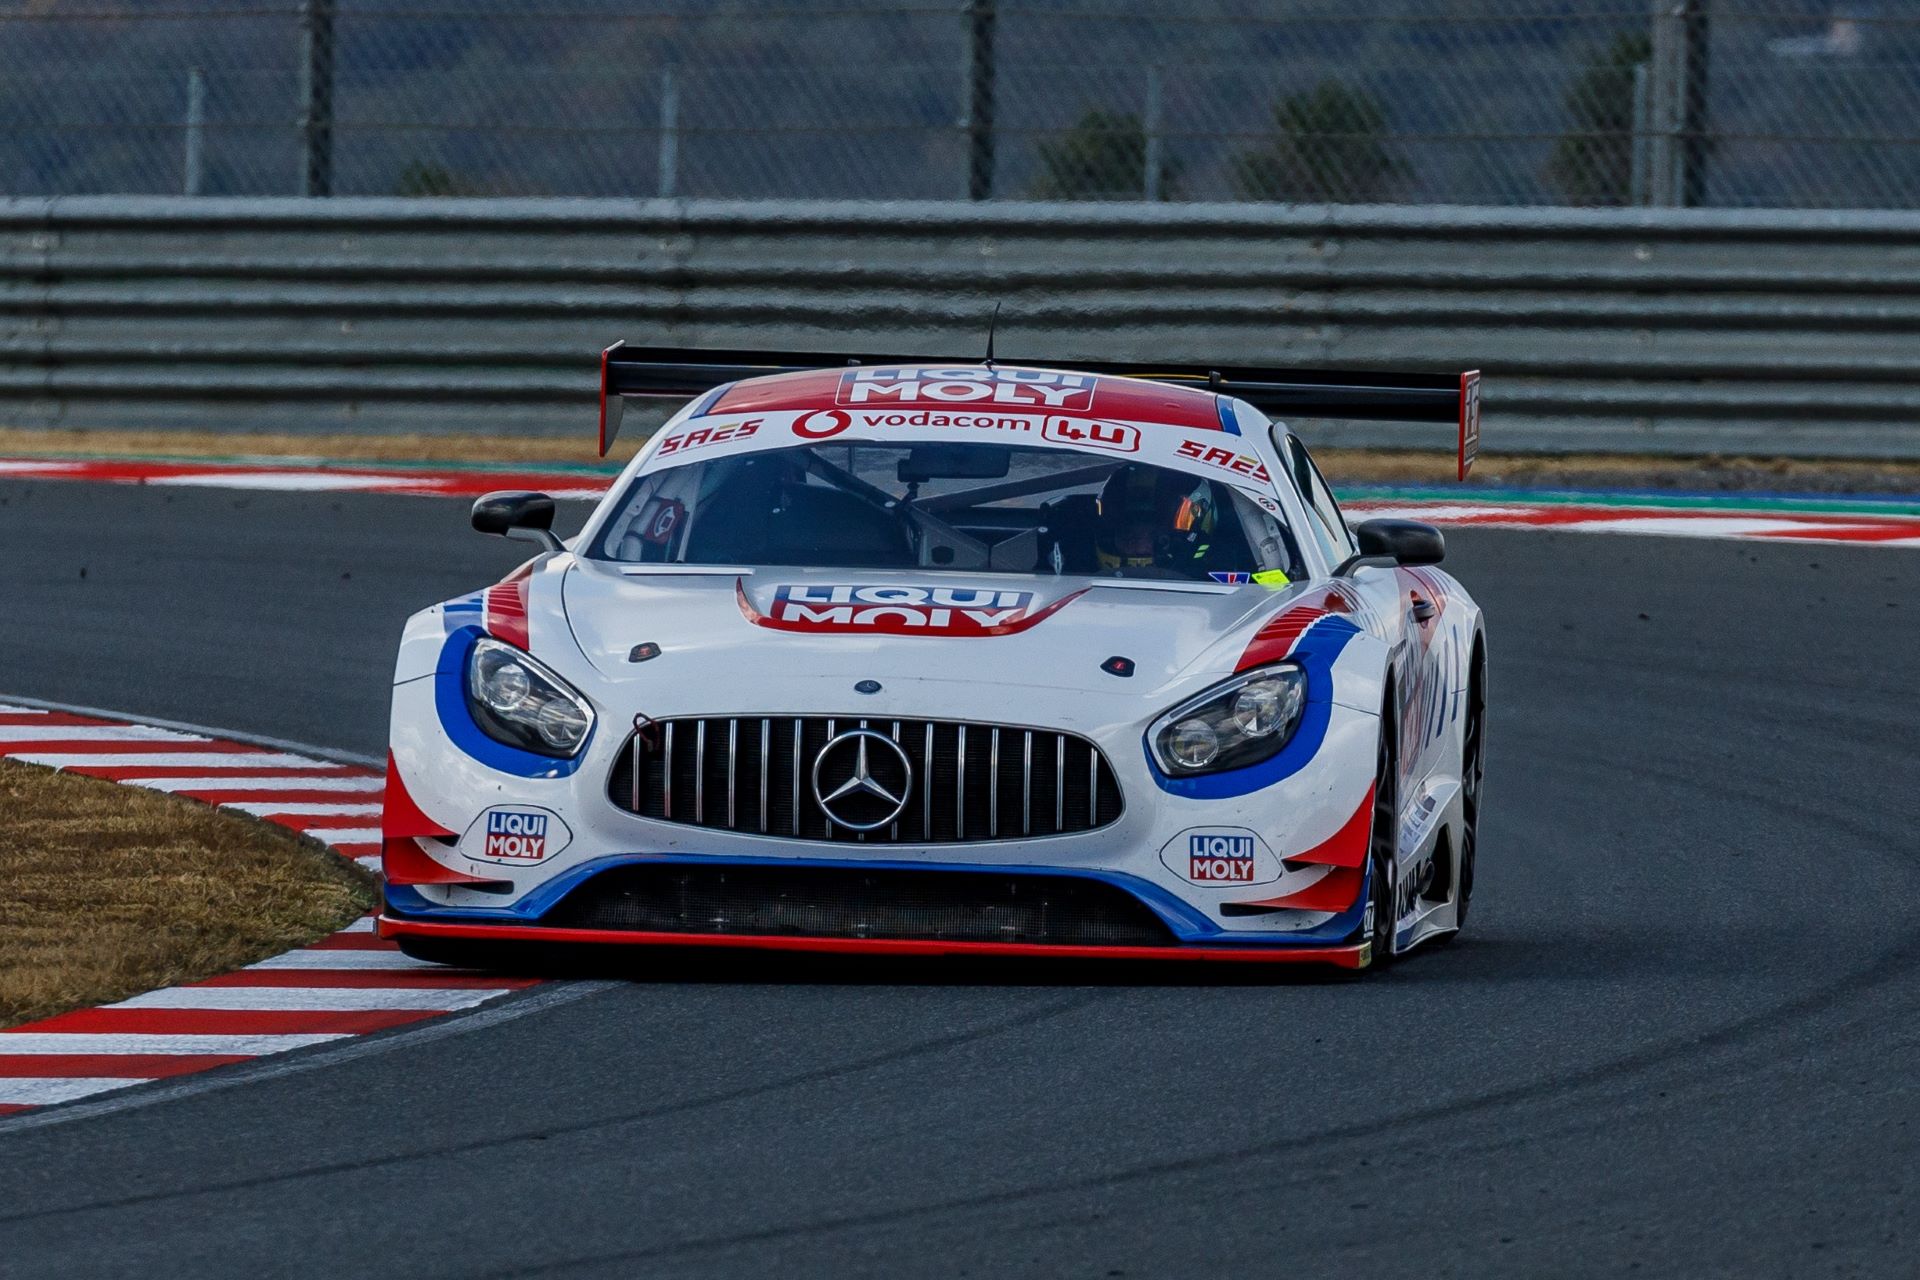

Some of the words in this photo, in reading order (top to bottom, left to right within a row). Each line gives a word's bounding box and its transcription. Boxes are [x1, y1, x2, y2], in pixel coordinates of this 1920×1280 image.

[850, 380, 1089, 406] MOLY
[658, 418, 765, 457] SAES
[862, 411, 1031, 431] vodacom
[1056, 419, 1125, 444] 4U
[787, 585, 1022, 608] LIQUI
[490, 813, 545, 836] LIQUI
[487, 835, 544, 857] MOLY
[1192, 837, 1251, 858] LIQUI
[1193, 859, 1253, 879] MOLY
